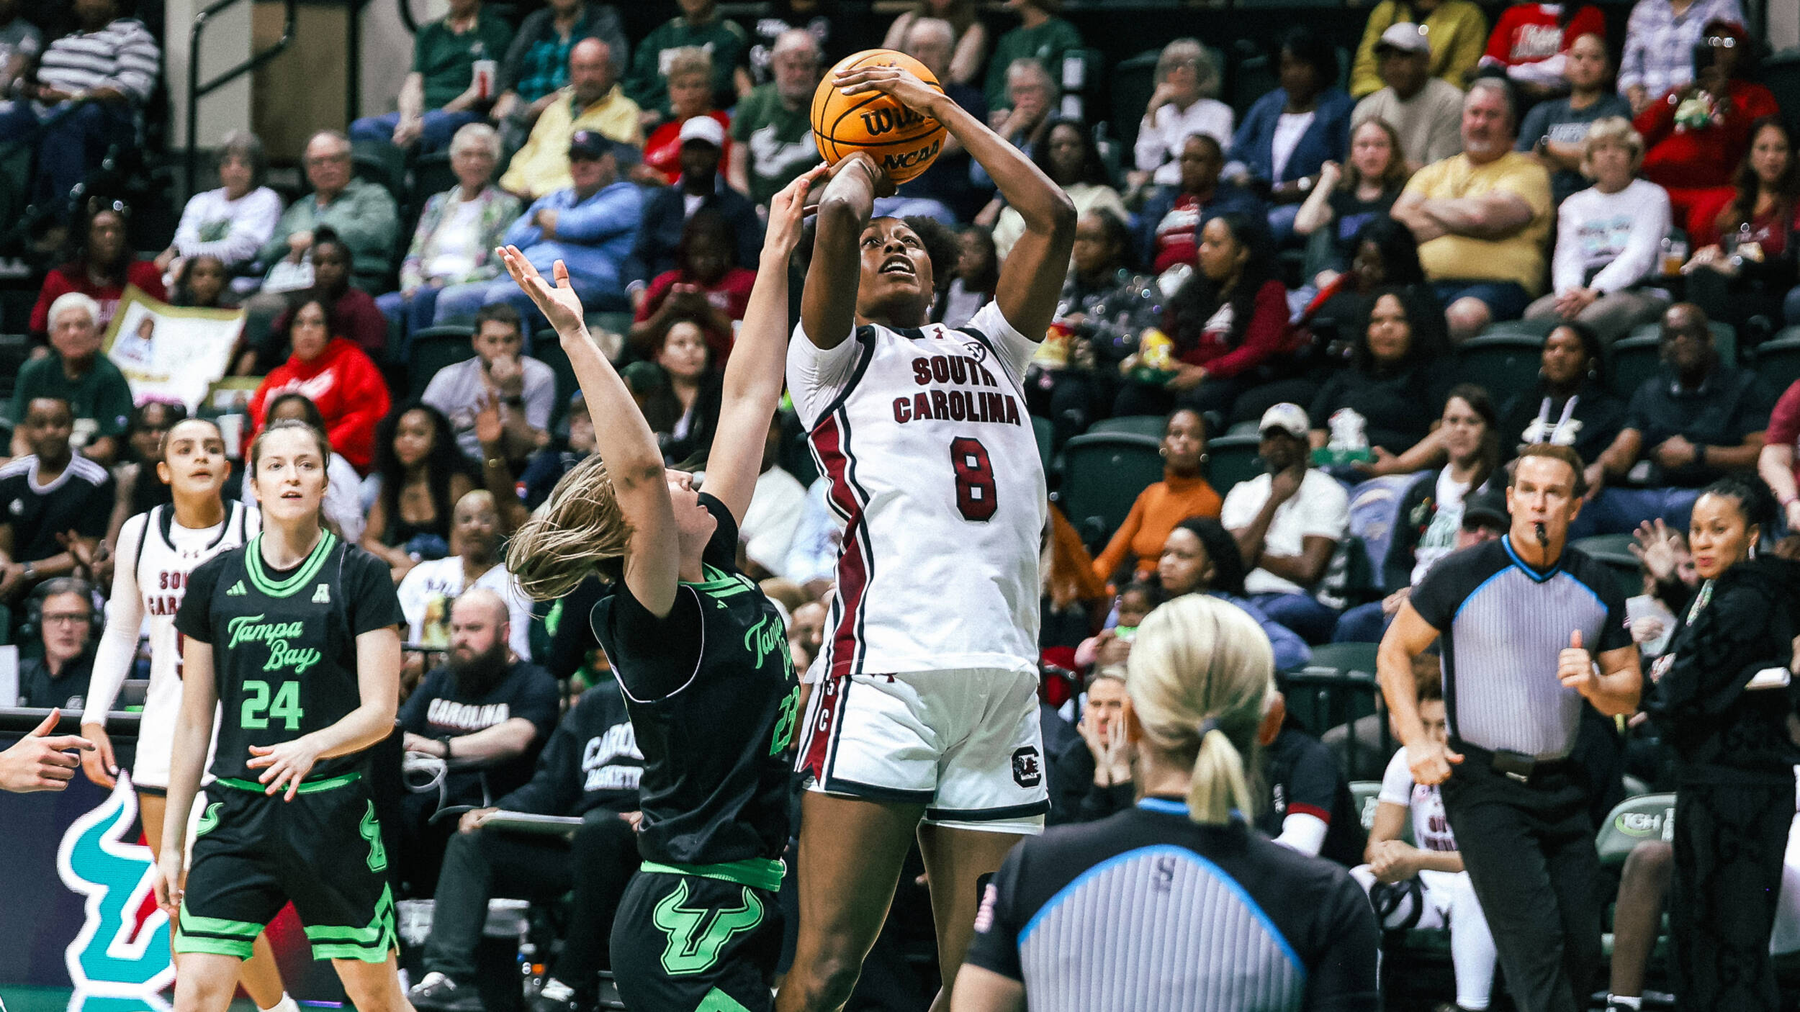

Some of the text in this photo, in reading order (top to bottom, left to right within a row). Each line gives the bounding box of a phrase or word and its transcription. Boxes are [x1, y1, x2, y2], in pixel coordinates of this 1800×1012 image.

[860, 103, 934, 136] Wil
[883, 139, 940, 170] NCAA
[911, 354, 998, 387] SOUTH
[892, 389, 1021, 427] CAROLINA
[949, 436, 998, 521] 8
[227, 613, 304, 650] Tampa
[262, 639, 322, 675] Bay
[240, 679, 305, 731] 24
[426, 697, 511, 732] CAROLINA
[768, 685, 800, 756] 23
[581, 721, 645, 773] CARO
[1621, 812, 1662, 831] TGH
